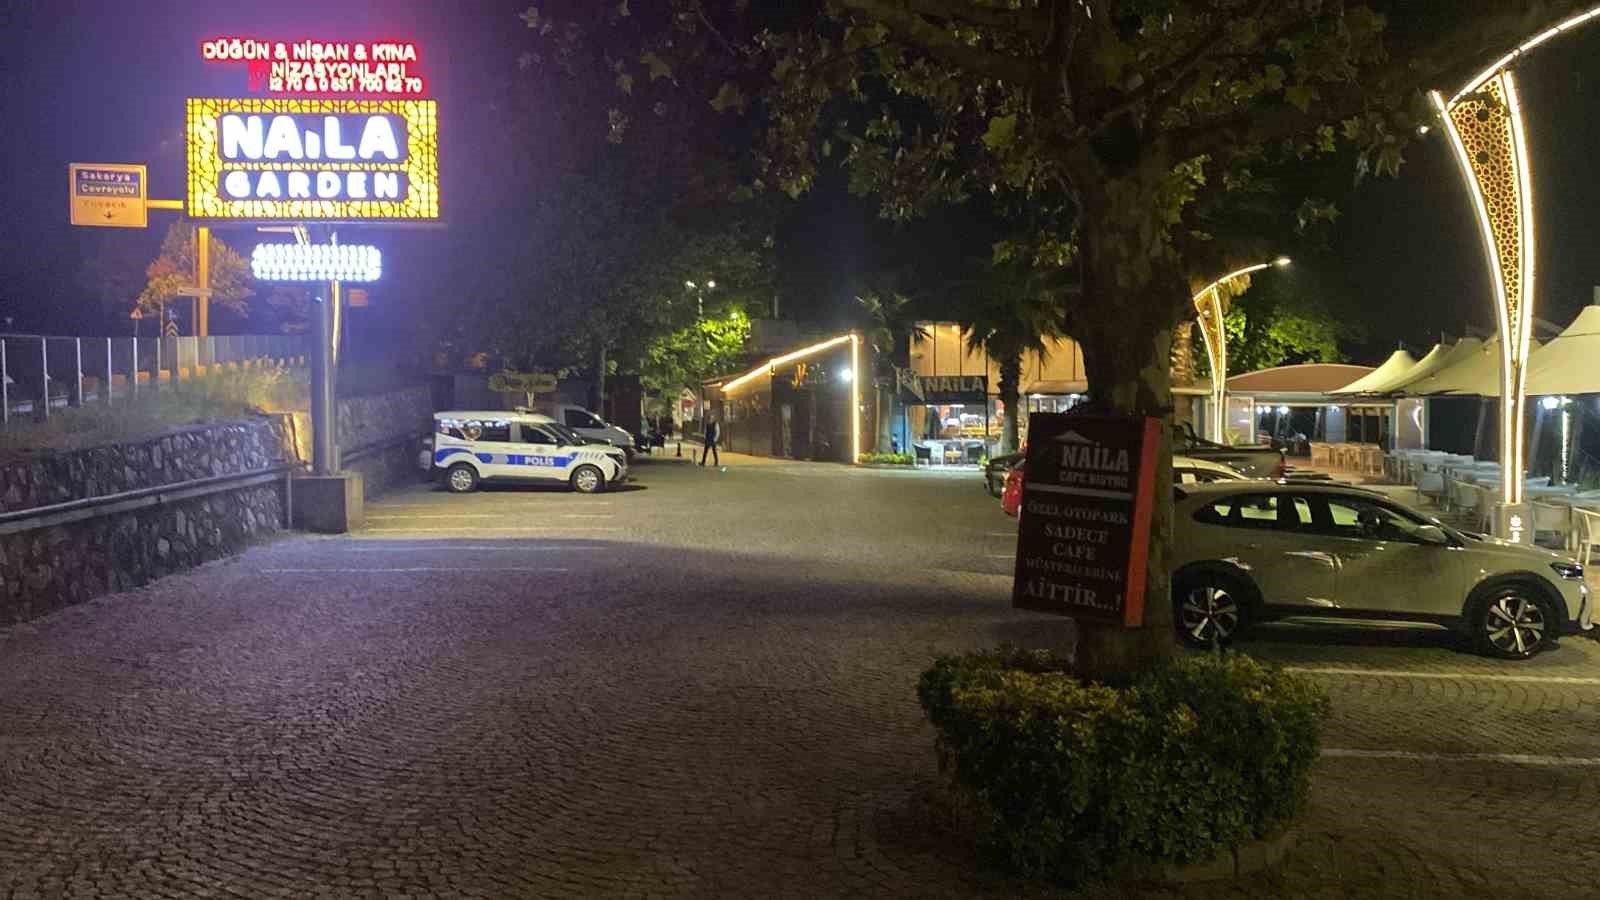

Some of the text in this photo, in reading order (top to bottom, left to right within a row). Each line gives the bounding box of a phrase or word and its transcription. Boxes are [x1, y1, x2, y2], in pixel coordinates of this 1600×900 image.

[274, 43, 288, 60] &
[355, 44, 367, 60] &
[372, 44, 416, 61] KINA
[405, 77, 422, 92] 70
[225, 171, 399, 199] GARDEN
[1063, 504, 1128, 526] OTOPARK
[1043, 524, 1109, 544] SADECE
[1052, 542, 1097, 561] CAFE
